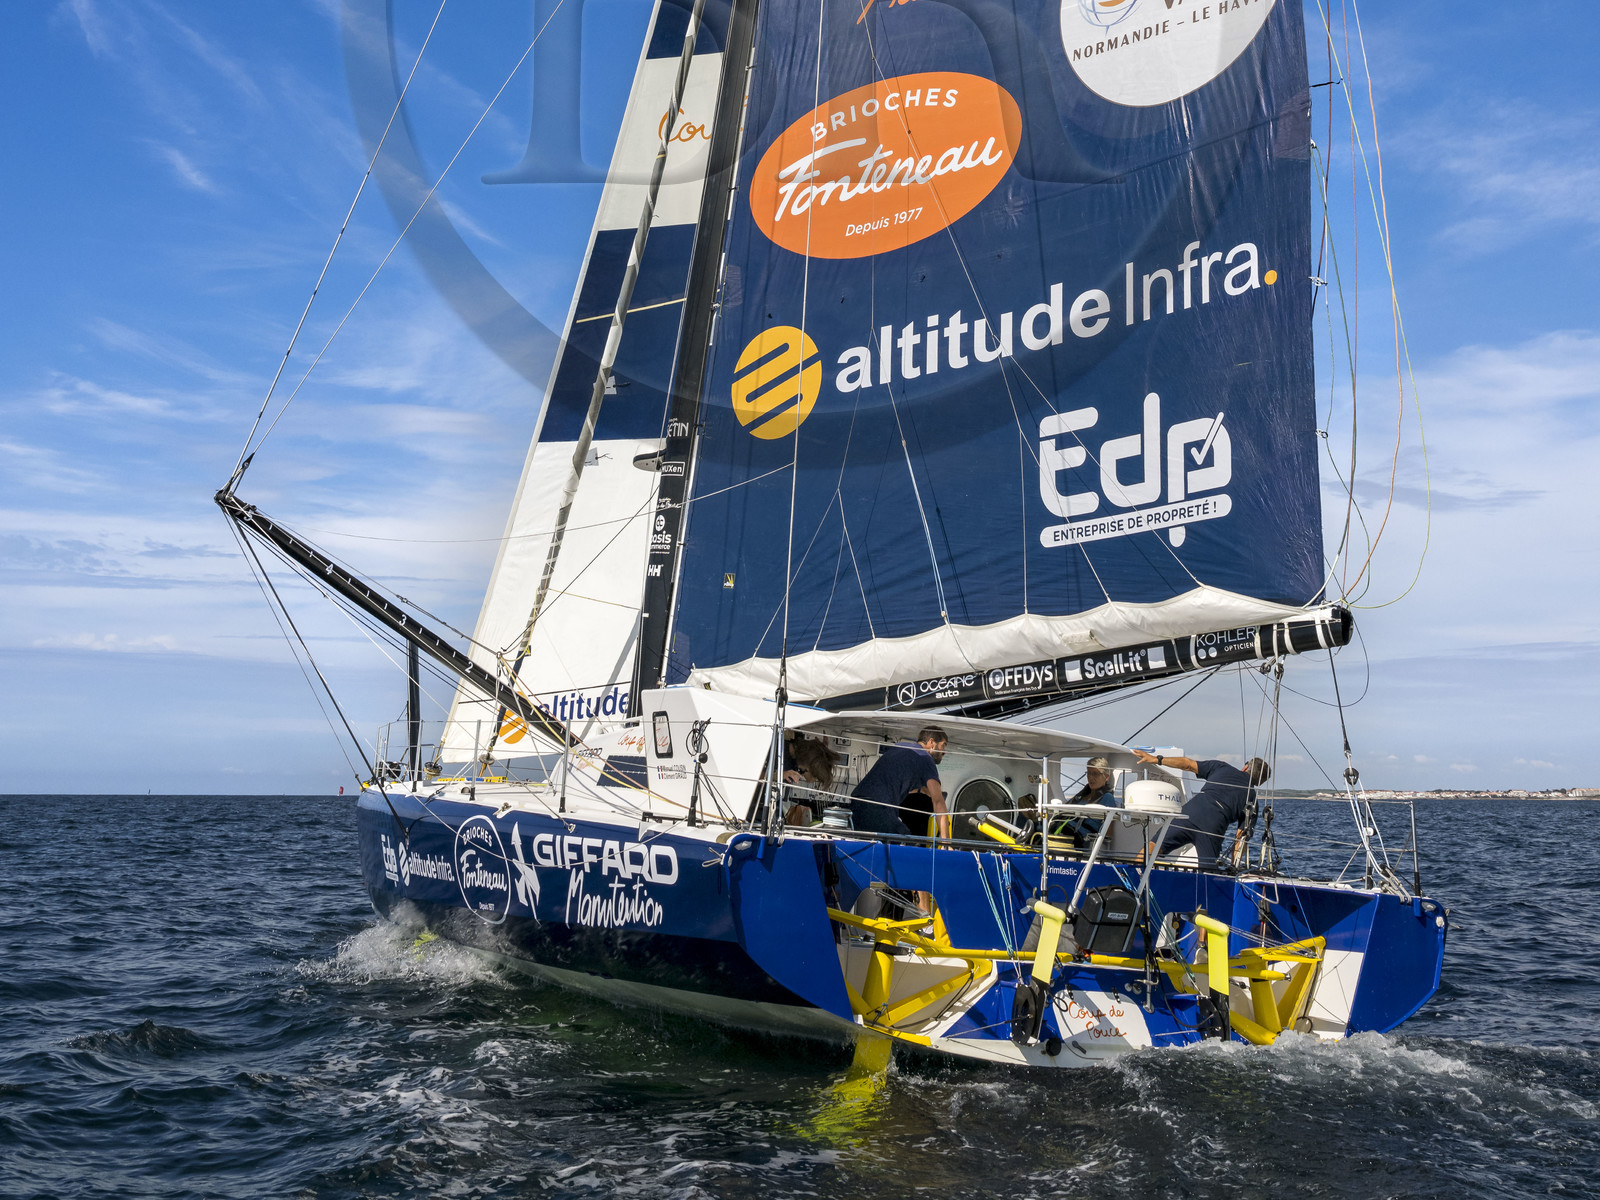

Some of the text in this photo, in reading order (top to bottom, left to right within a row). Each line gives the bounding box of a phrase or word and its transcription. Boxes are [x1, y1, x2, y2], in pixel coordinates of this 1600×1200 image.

[1072, 21, 1170, 61] NORMANDIE
[1192, 8, 1210, 25] LE
[810, 87, 959, 142] BRIOCHES
[774, 135, 1003, 223] Fonteneau
[845, 207, 923, 237] Depuis 1977
[835, 282, 1111, 393] altitude
[1053, 519, 1124, 542] ENTREPRISE
[1127, 516, 1143, 530] DE
[1146, 500, 1210, 525] PROPRETÉ
[325, 563, 334, 575] 4
[399, 614, 407, 626] 3
[465, 661, 474, 673] 2
[935, 689, 960, 699] auto
[462, 826, 493, 847] BRIOCHES
[460, 849, 508, 892] Fonteneau
[532, 833, 679, 886] GIFFARD
[564, 869, 664, 930] Manutention
[1108, 1005, 1125, 1018] de
